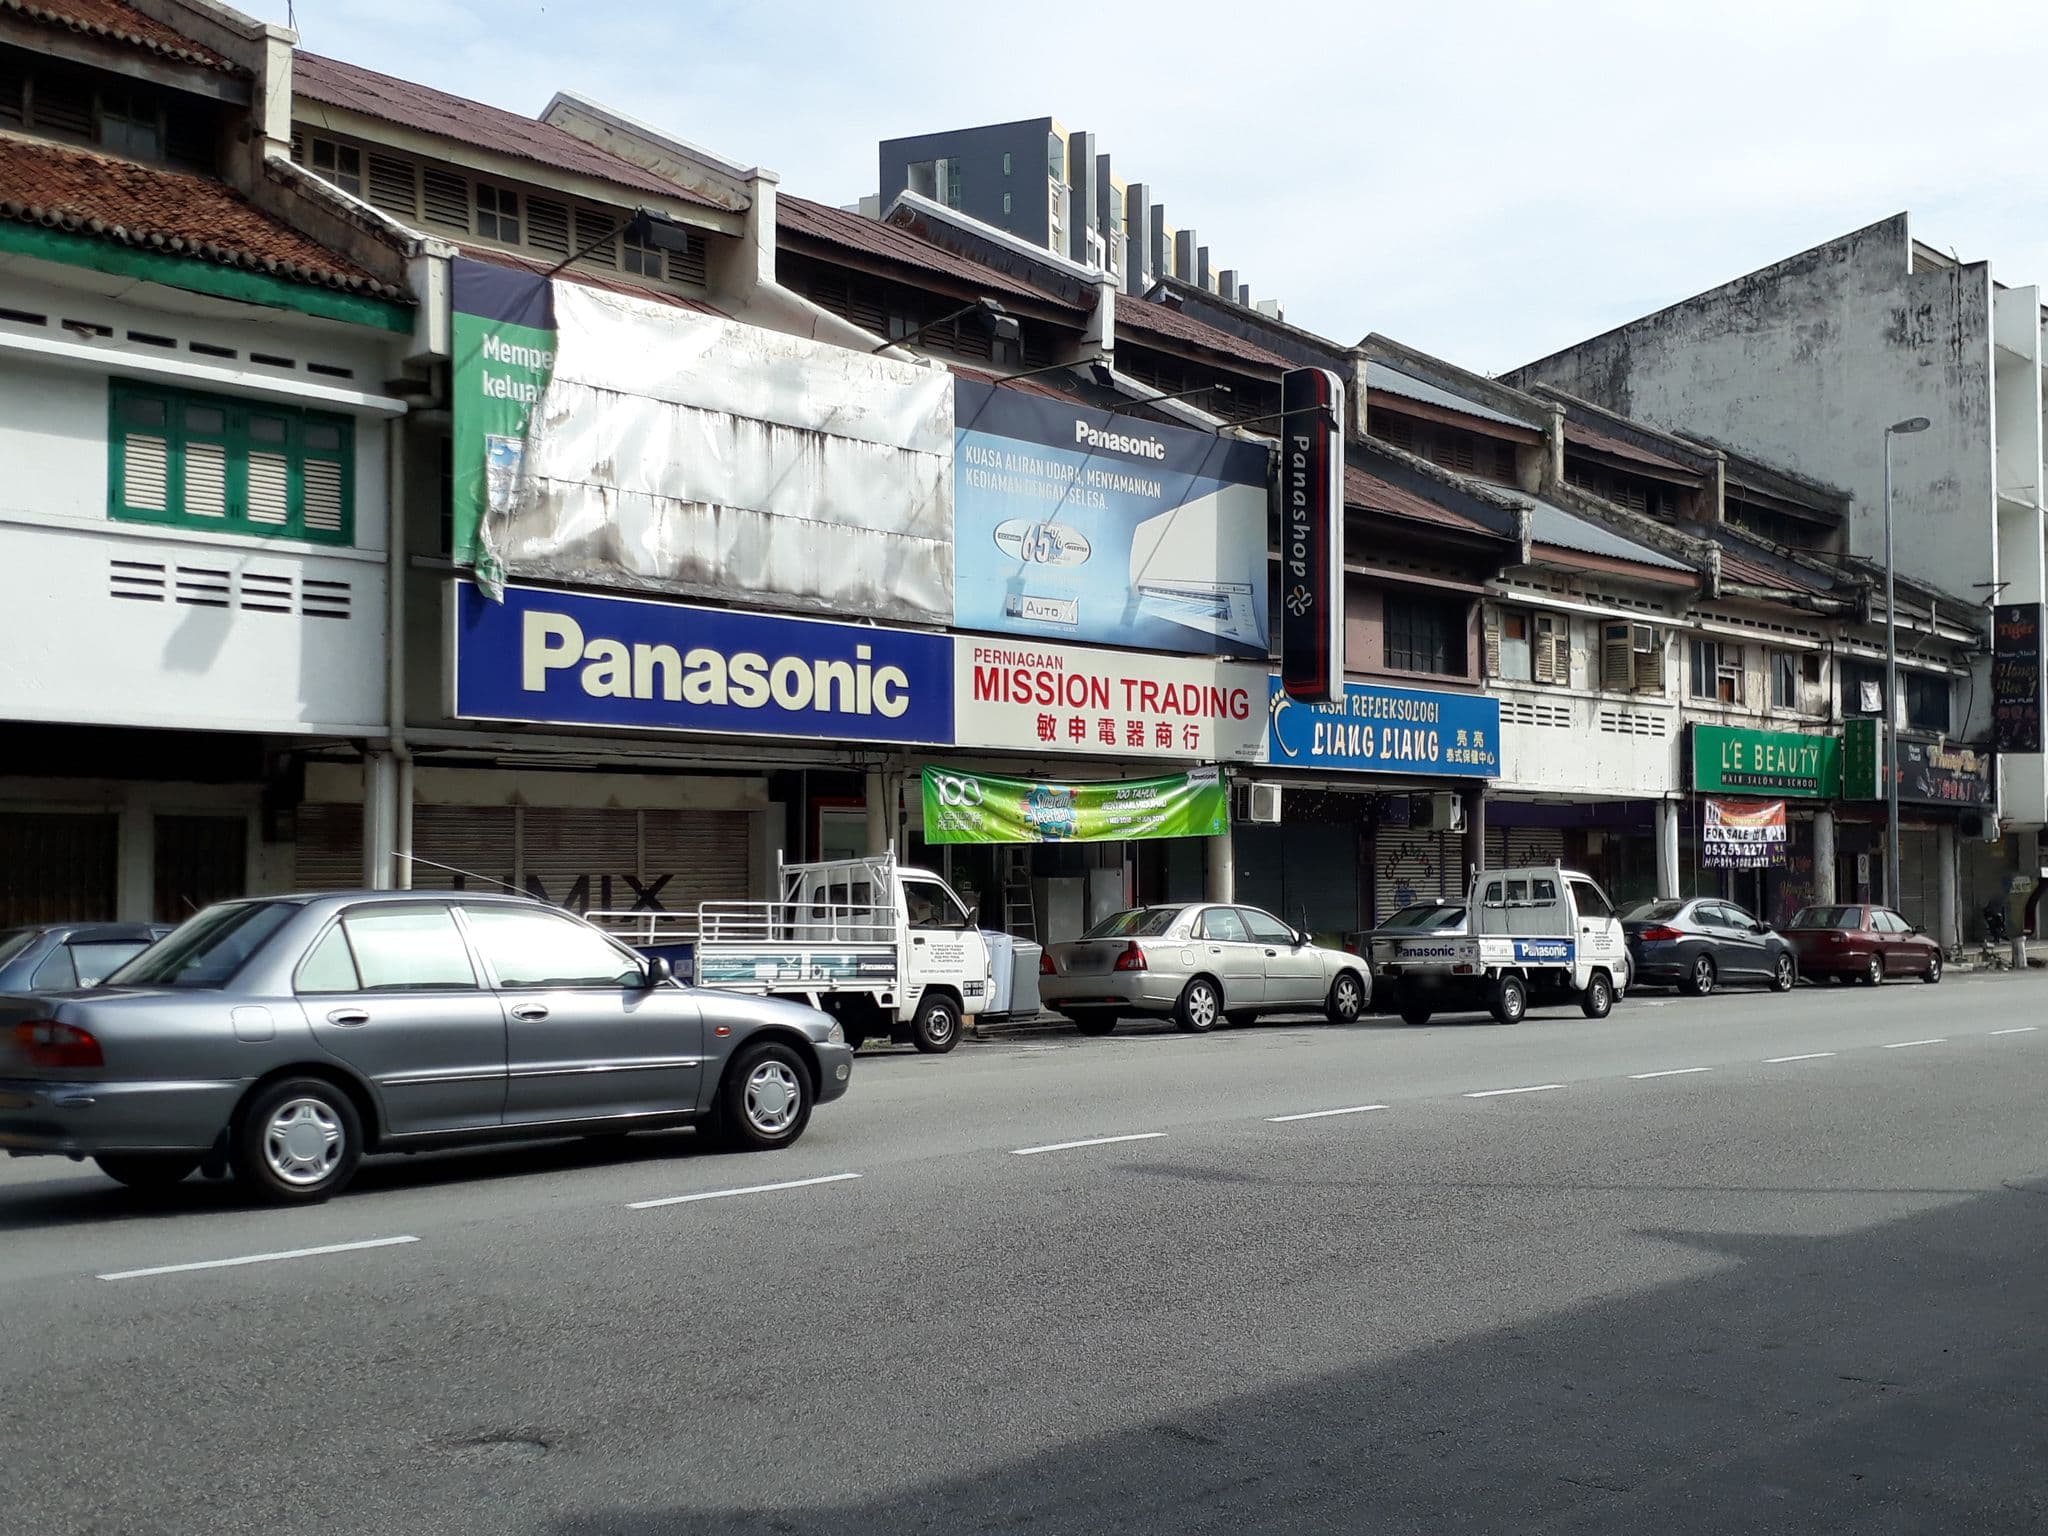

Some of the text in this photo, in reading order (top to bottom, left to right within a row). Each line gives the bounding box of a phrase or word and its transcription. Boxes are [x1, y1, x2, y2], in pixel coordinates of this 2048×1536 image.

[1075, 420, 1165, 461] Panasonic
[965, 446, 1162, 499] KUASA ALIRAN UDARA, MENYAMANKAN
[1069, 487, 1109, 511] SELESA.
[1291, 435, 1311, 578] Panashop
[522, 609, 910, 719] Panasonic
[973, 648, 1063, 670] PERNIAGAAN
[973, 665, 1249, 720] MISSION TRADING
[1352, 694, 1439, 723] REFLEKSOLOGI
[1036, 713, 1200, 750] 敏申電器商行
[1311, 722, 1438, 762] LIANG LIANG
[1755, 744, 1819, 775] BEAUTY
[934, 775, 983, 807] 100
[1116, 788, 1158, 800] 100 TAHUN
[1722, 774, 1742, 784] HAIR
[1748, 775, 1773, 786] SALON
[1787, 778, 1817, 789] SCHOOL
[1706, 827, 1725, 840] FOR
[1727, 828, 1749, 841] SALE
[1394, 944, 1455, 957] Panasonic
[1522, 943, 1567, 958] Panasonic
[860, 963, 895, 971] Panasonic
